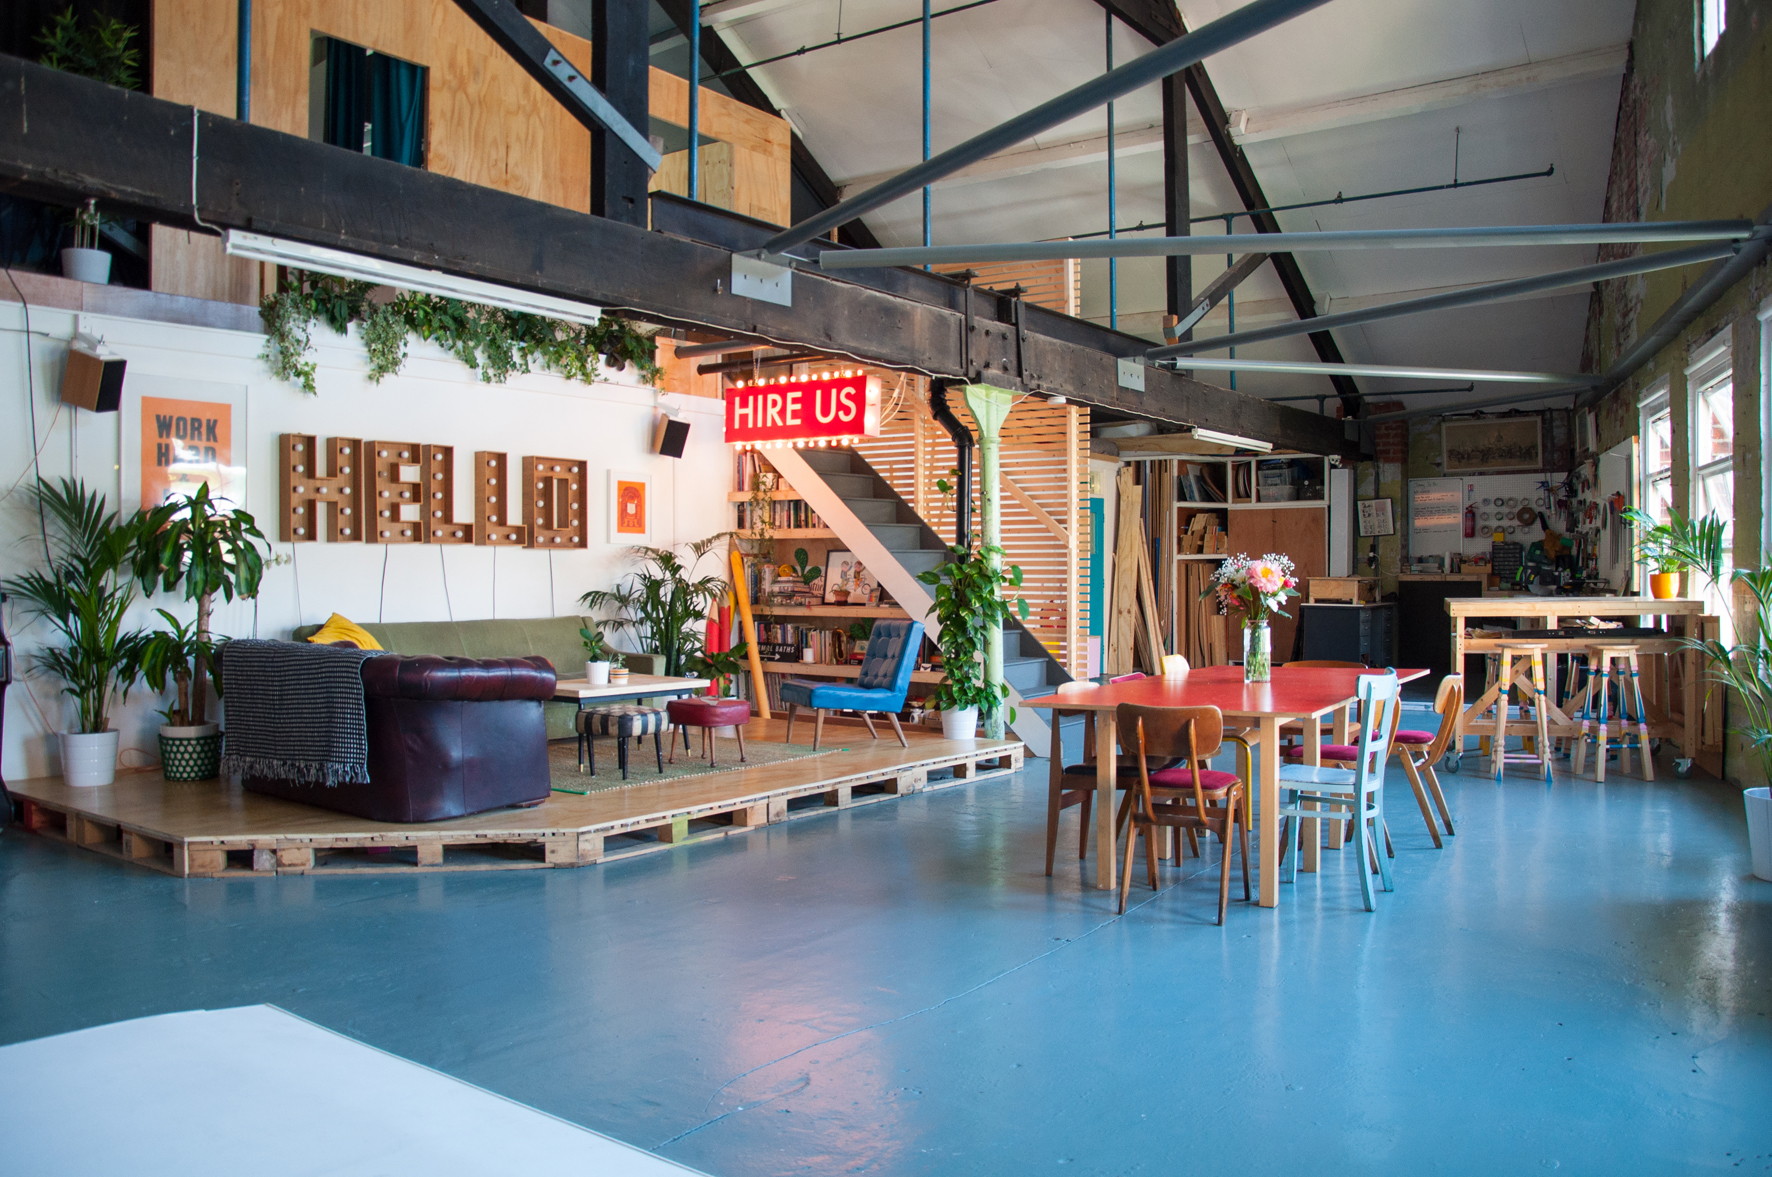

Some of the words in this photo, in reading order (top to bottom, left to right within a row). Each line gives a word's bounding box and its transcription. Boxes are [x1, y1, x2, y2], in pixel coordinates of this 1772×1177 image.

[734, 391, 802, 429] HIRE
[815, 386, 857, 424] US
[155, 414, 218, 442] WORK
[279, 433, 588, 549] HELLO
[775, 645, 795, 653] BATHS
